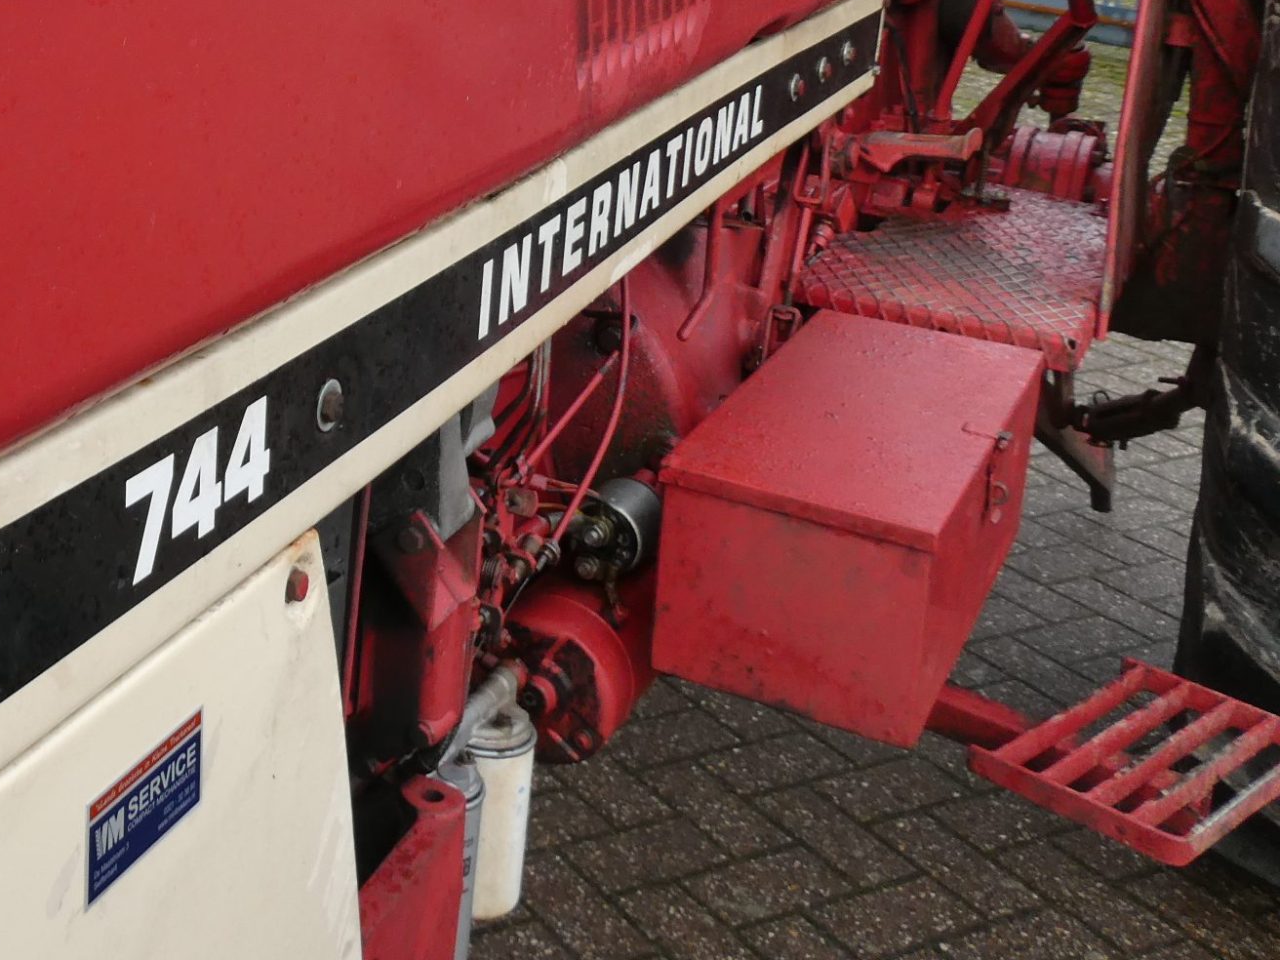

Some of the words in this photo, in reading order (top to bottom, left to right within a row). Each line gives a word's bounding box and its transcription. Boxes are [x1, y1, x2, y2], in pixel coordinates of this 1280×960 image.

[477, 84, 764, 341] INTERNATIONAL
[125, 395, 270, 587] 744
[127, 742, 197, 820] SERVICE
